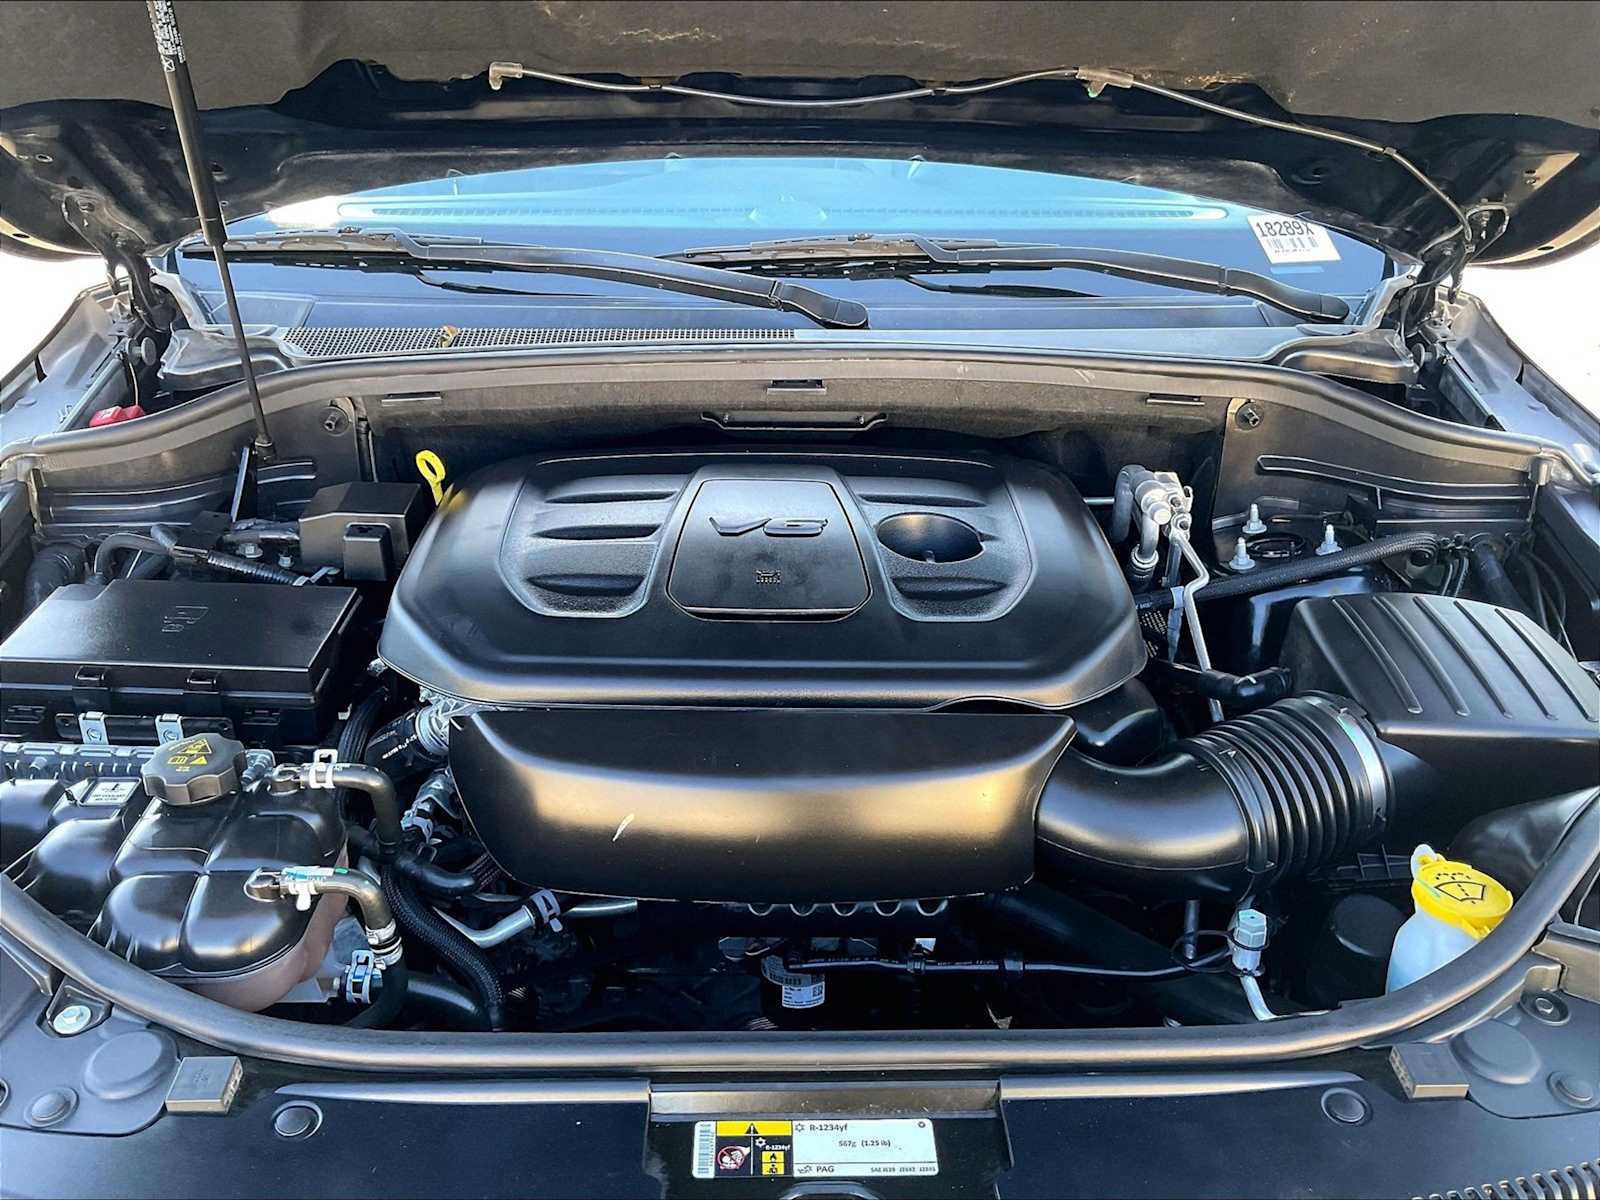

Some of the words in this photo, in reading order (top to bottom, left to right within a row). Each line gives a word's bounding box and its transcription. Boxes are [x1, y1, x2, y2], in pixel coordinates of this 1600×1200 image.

[1255, 220, 1315, 238] 18289X
[708, 516, 828, 538] V6
[809, 1122, 848, 1133] R-1234yf
[861, 1140, 880, 1148] (1.25
[816, 1166, 835, 1174] PAG
